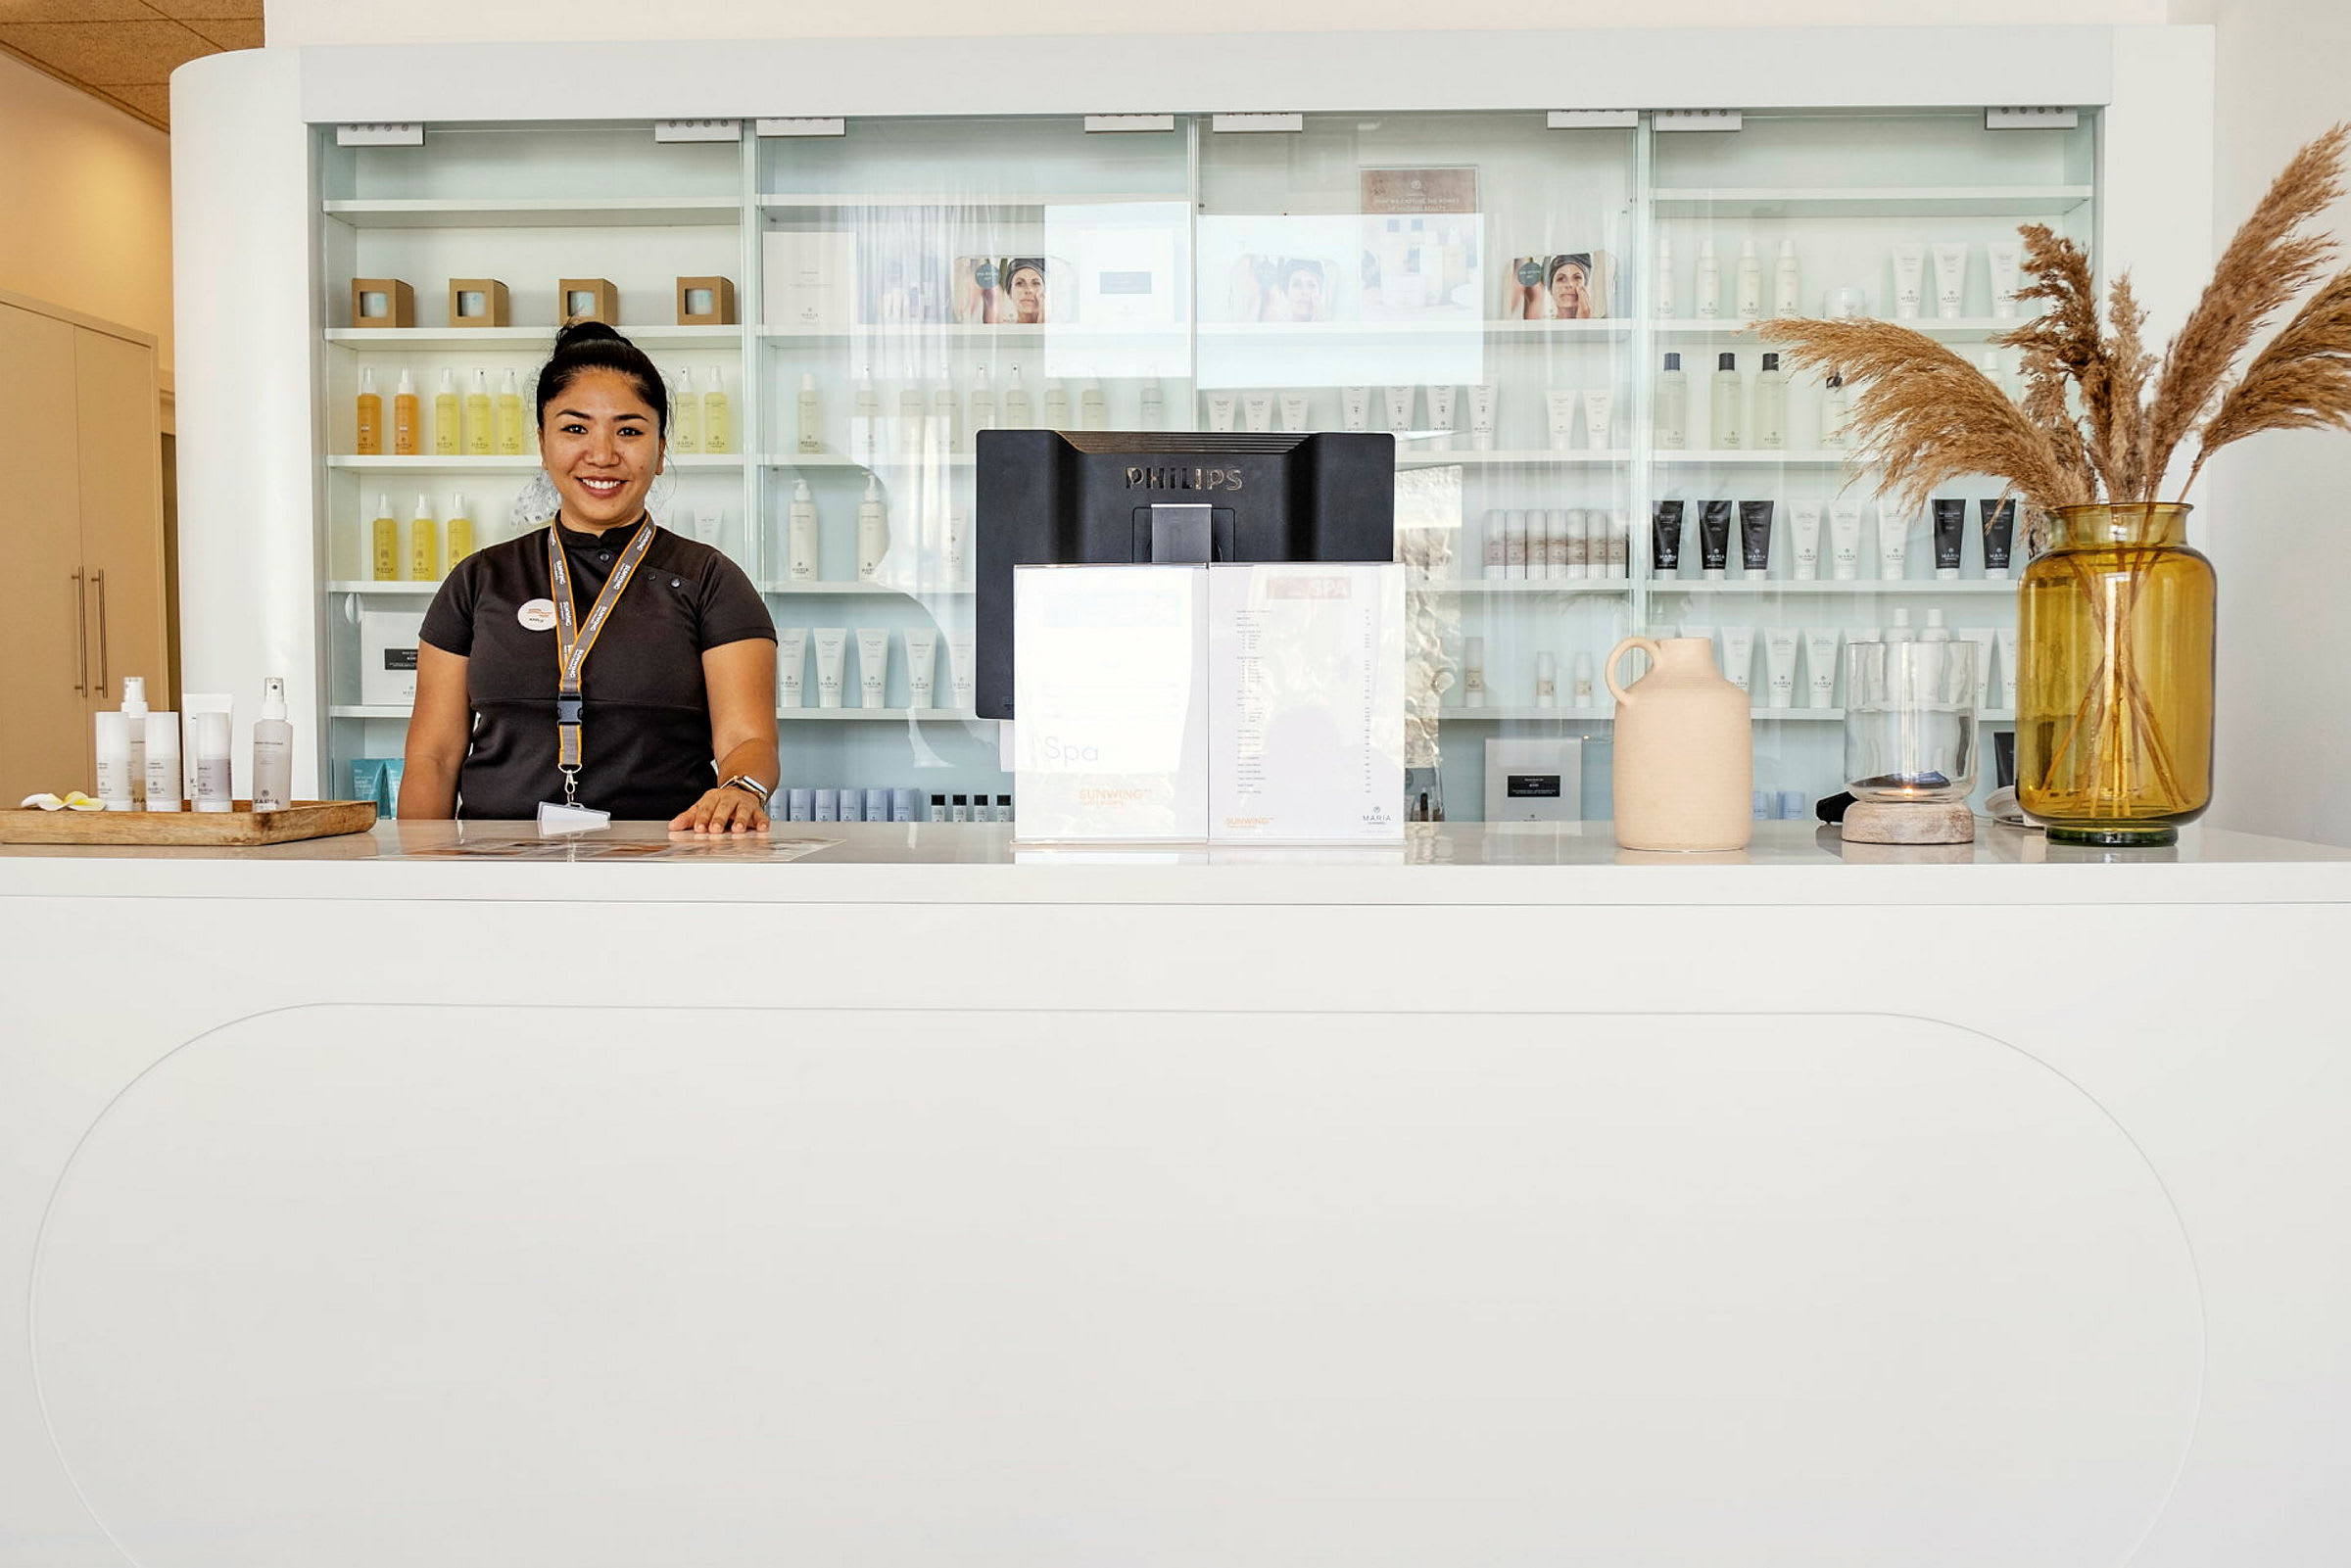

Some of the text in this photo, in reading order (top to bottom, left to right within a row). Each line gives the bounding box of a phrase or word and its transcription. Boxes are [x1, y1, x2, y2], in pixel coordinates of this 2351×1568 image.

[1126, 466, 1243, 491] PHILIPS
[613, 564, 632, 591] SUNWING
[1308, 579, 1349, 596] SPA
[590, 605, 608, 632] SUNWING
[1043, 736, 1099, 767] Spa
[1080, 787, 1144, 800] SUNWING
